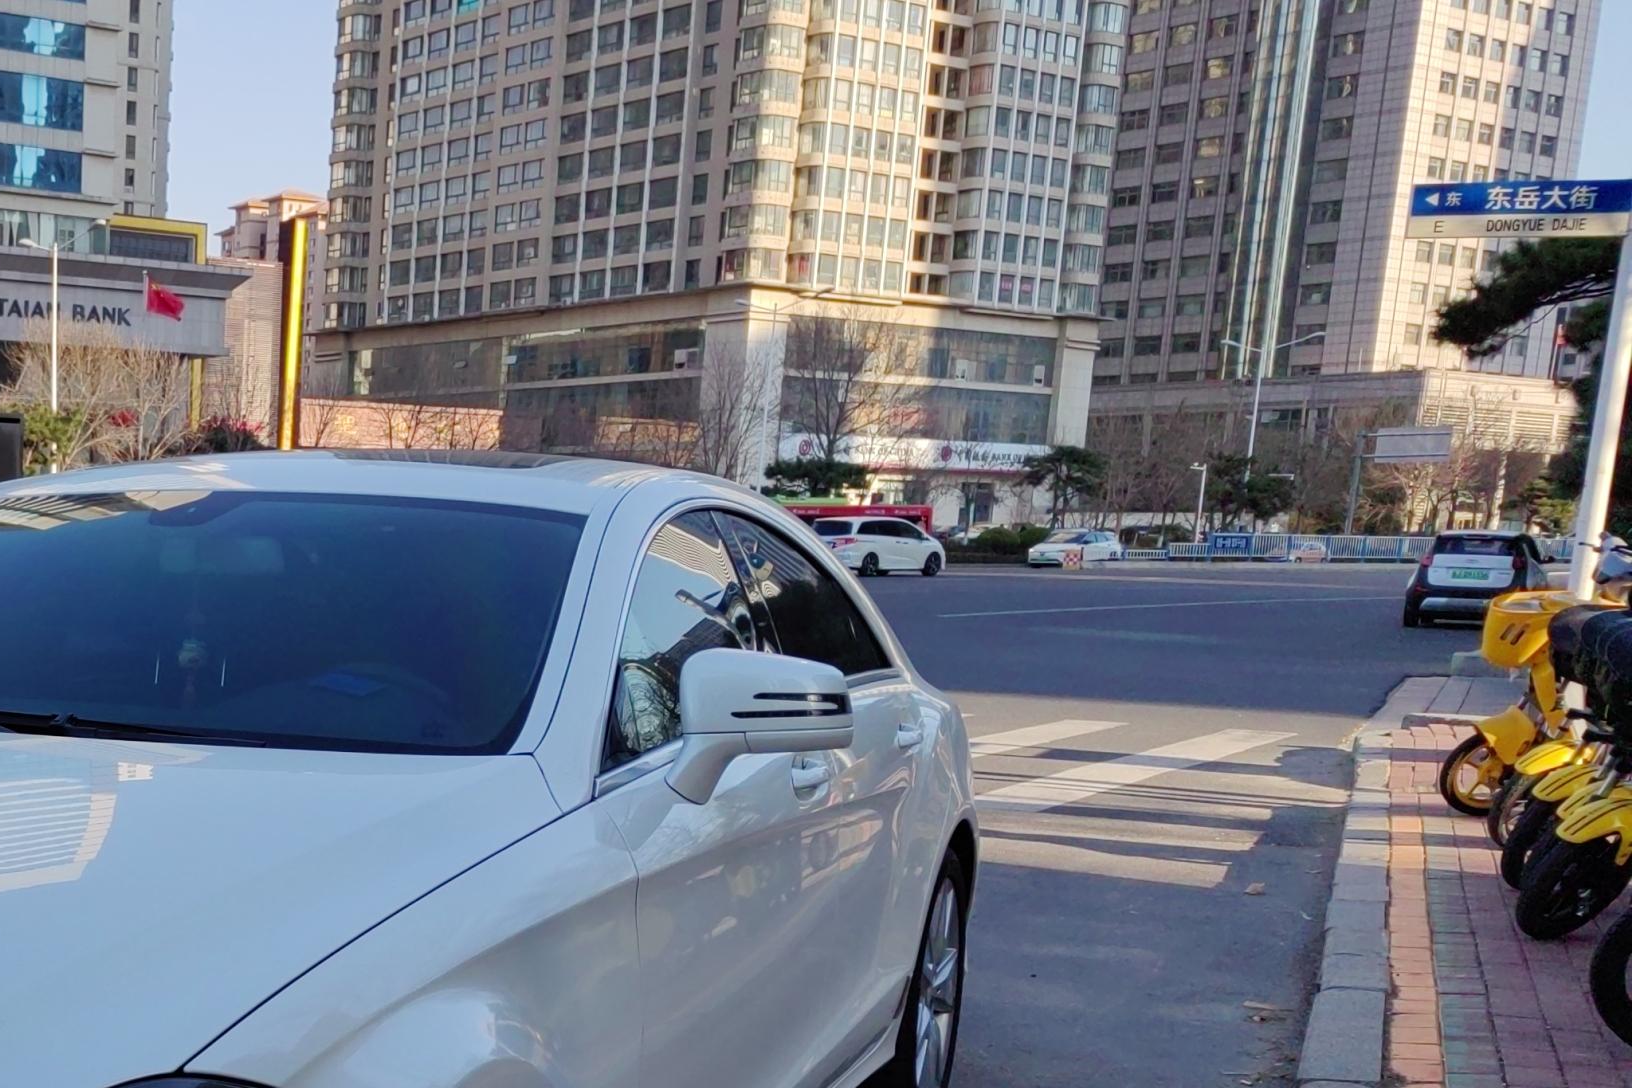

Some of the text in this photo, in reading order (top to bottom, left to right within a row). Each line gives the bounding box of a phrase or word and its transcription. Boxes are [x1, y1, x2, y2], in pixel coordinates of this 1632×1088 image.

[1445, 185, 1599, 210] 东 东岳大街
[1434, 217, 1587, 233] E DONGYUE DAJIE
[71, 303, 132, 327] BANK
